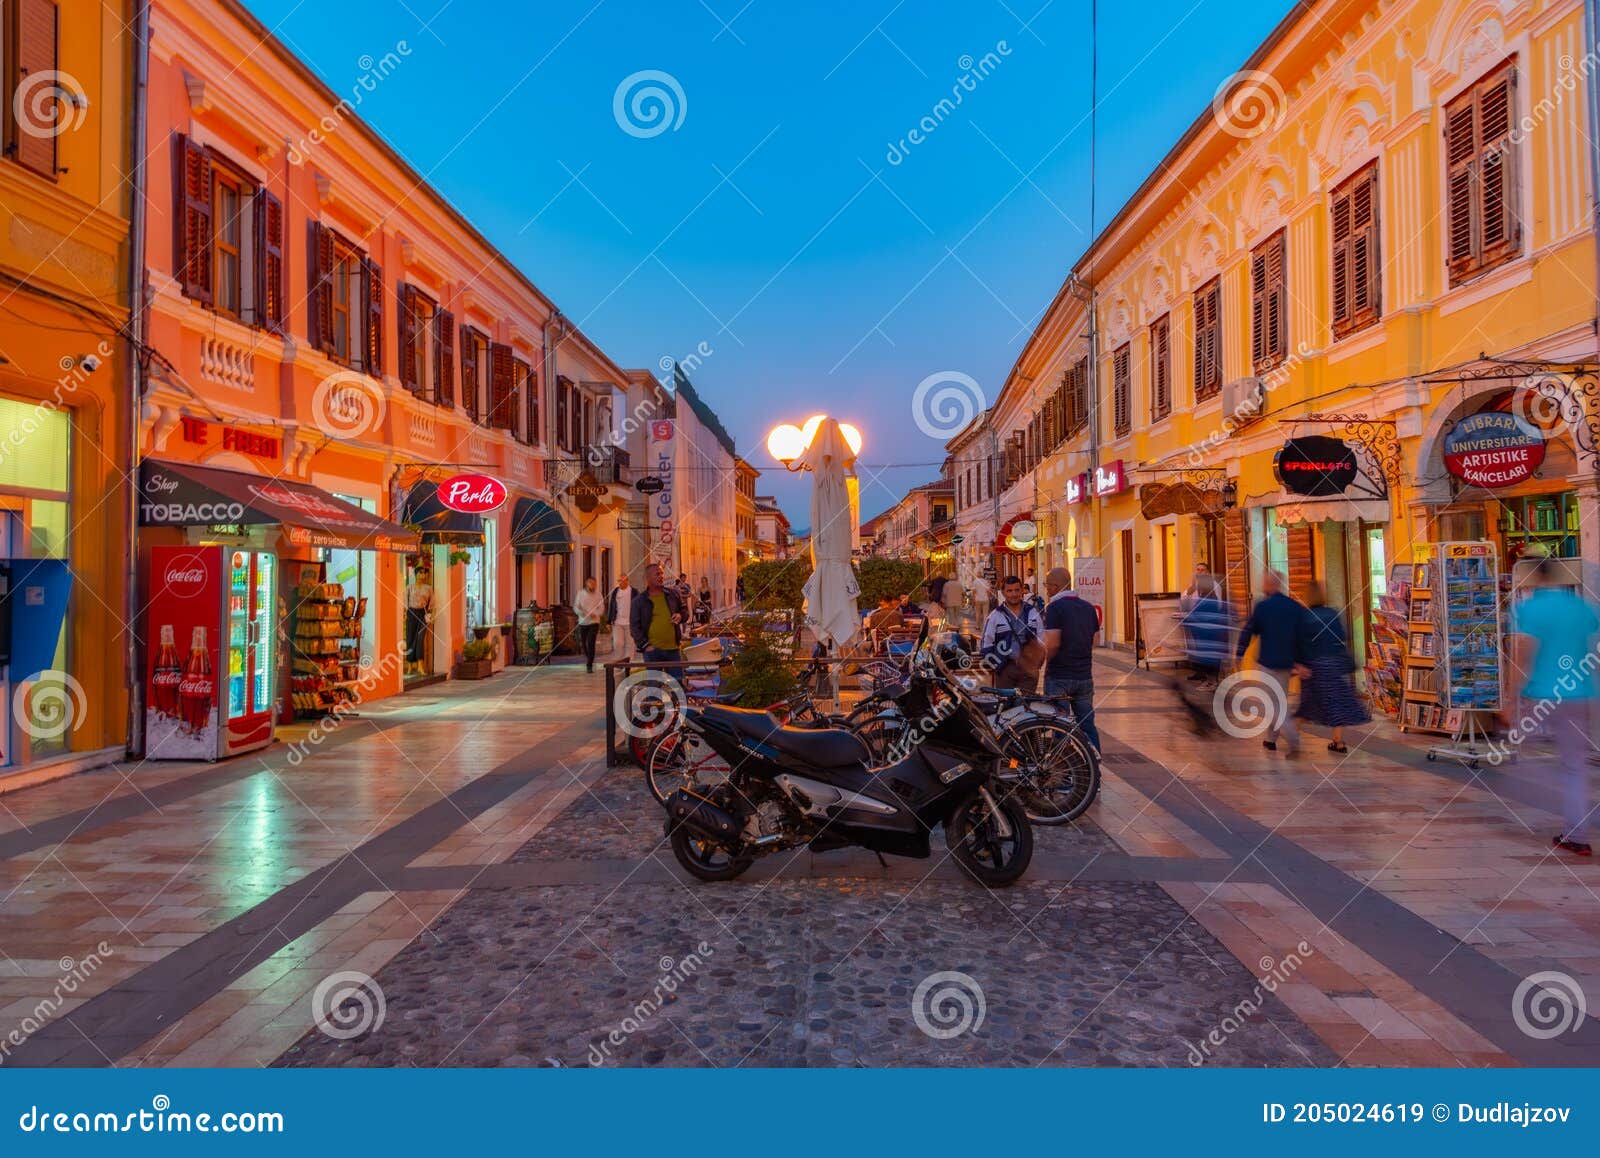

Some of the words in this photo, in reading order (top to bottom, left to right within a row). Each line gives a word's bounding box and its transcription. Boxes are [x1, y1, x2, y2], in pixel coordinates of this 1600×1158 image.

[1463, 416, 1517, 433] LIBRARI
[181, 416, 207, 445] TE
[223, 427, 278, 459] FREDI
[1451, 435, 1533, 453] UNIVERSITARE
[1462, 450, 1528, 468] ARTISTIKE
[1464, 464, 1527, 483] KANCELARI
[145, 475, 179, 494] Shop
[449, 481, 495, 504] Perla
[141, 503, 244, 522] TOBACCO
